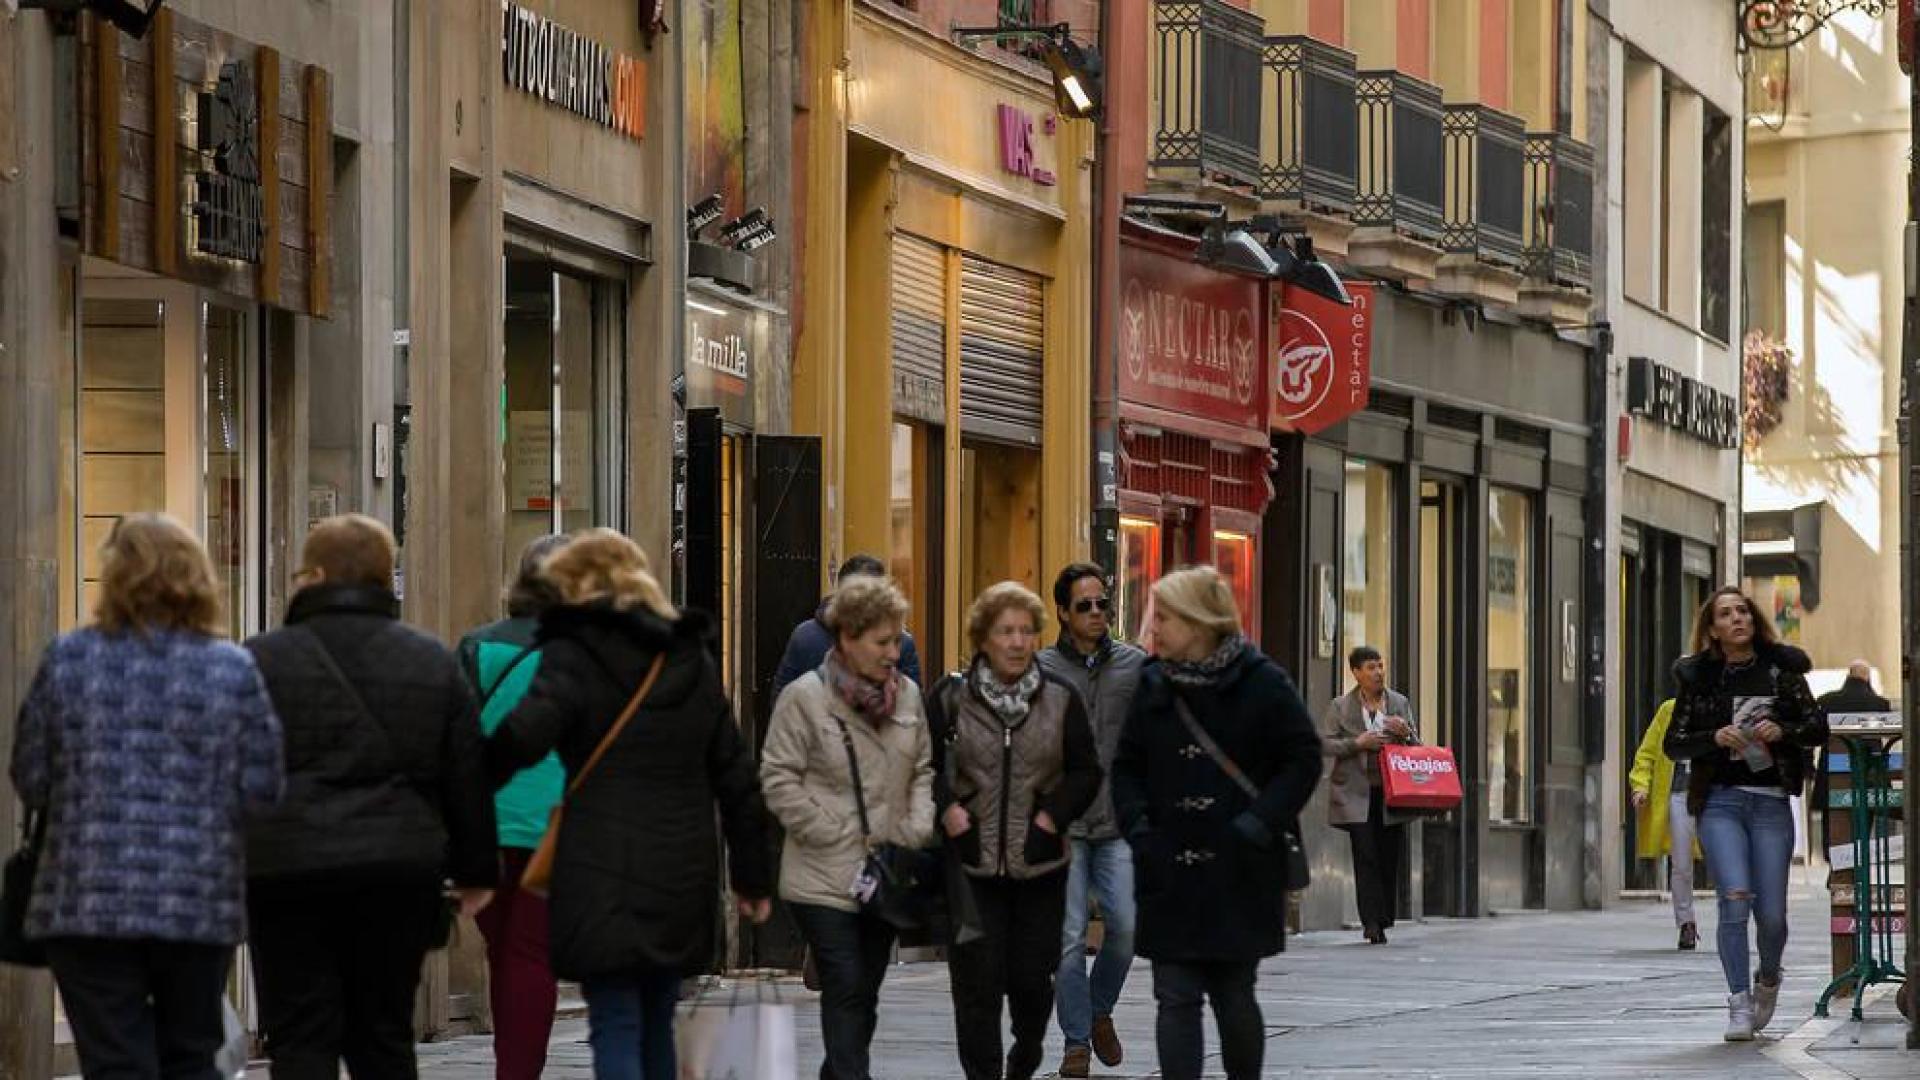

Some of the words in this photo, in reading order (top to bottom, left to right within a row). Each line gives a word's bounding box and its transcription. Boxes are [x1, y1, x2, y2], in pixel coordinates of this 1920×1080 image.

[692, 322, 705, 365] la
[707, 335, 747, 378] milla
[1147, 290, 1231, 371] NECTAR
[1350, 295, 1365, 404] nectar
[1388, 754, 1454, 774] rebajas
